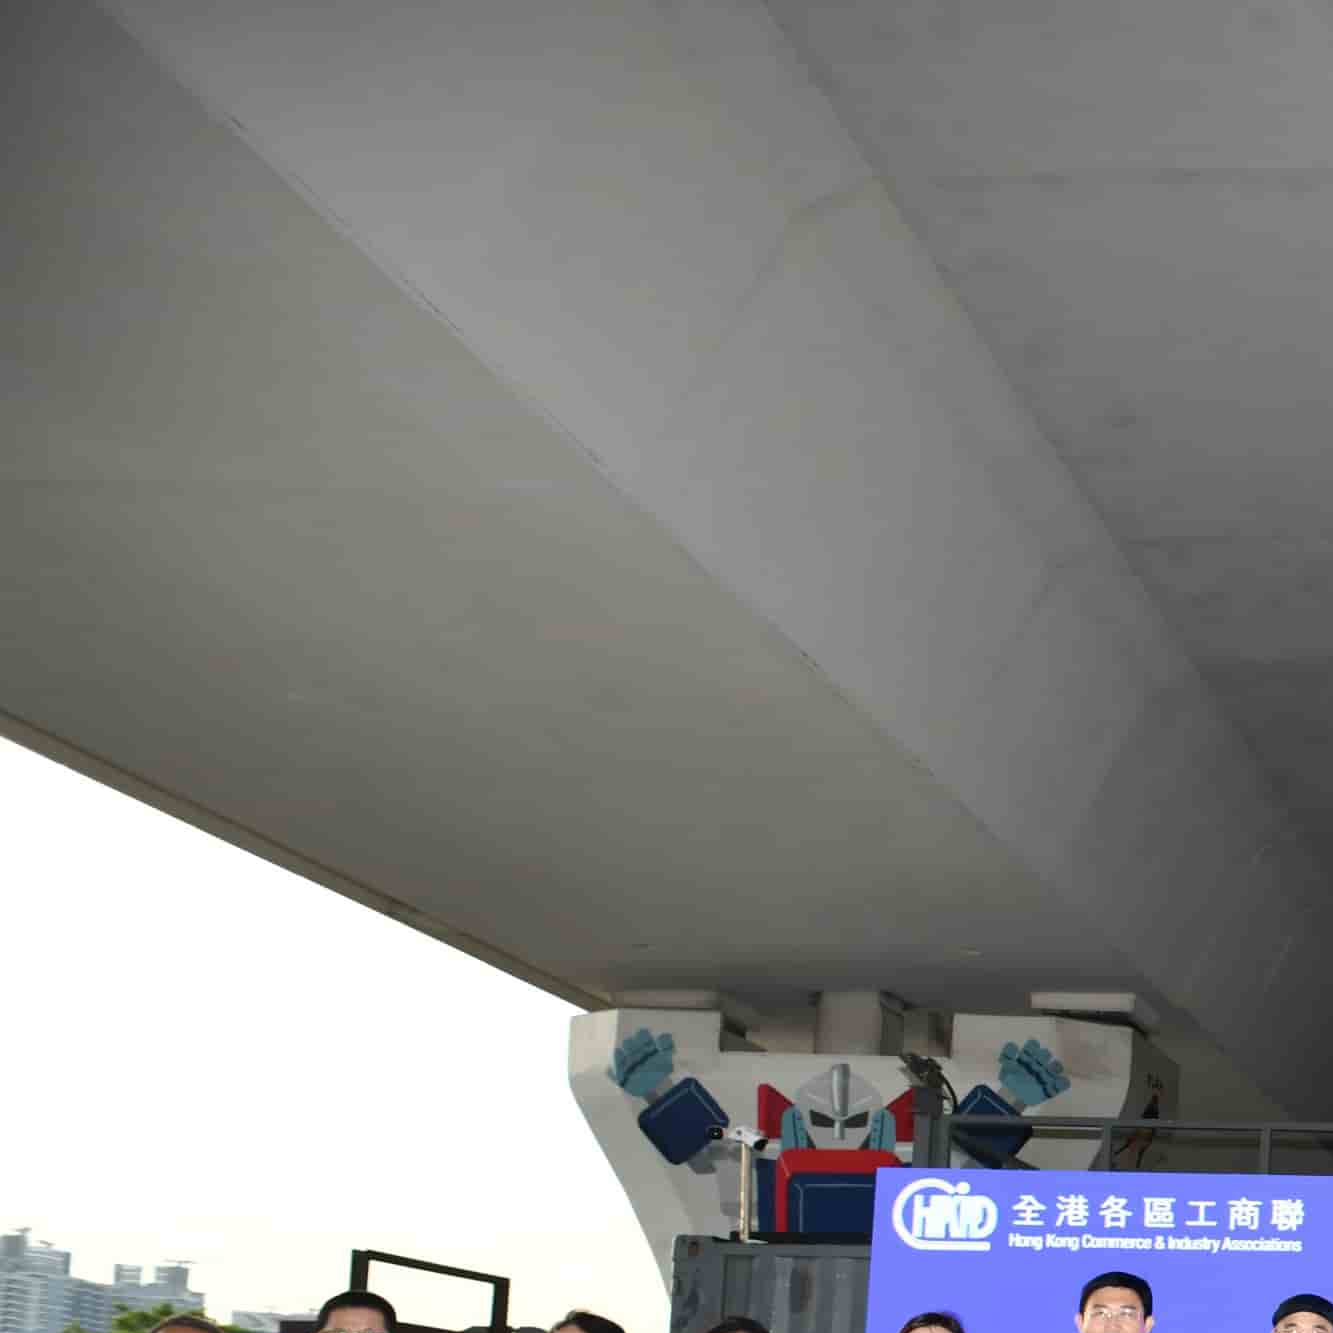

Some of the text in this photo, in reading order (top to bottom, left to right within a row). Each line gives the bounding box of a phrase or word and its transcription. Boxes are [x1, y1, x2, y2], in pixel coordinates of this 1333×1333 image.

[1012, 1194, 1304, 1231] 全港各區工商聯
[1008, 1232, 1303, 1254] Hong Kong Commerce & Industry Associations
